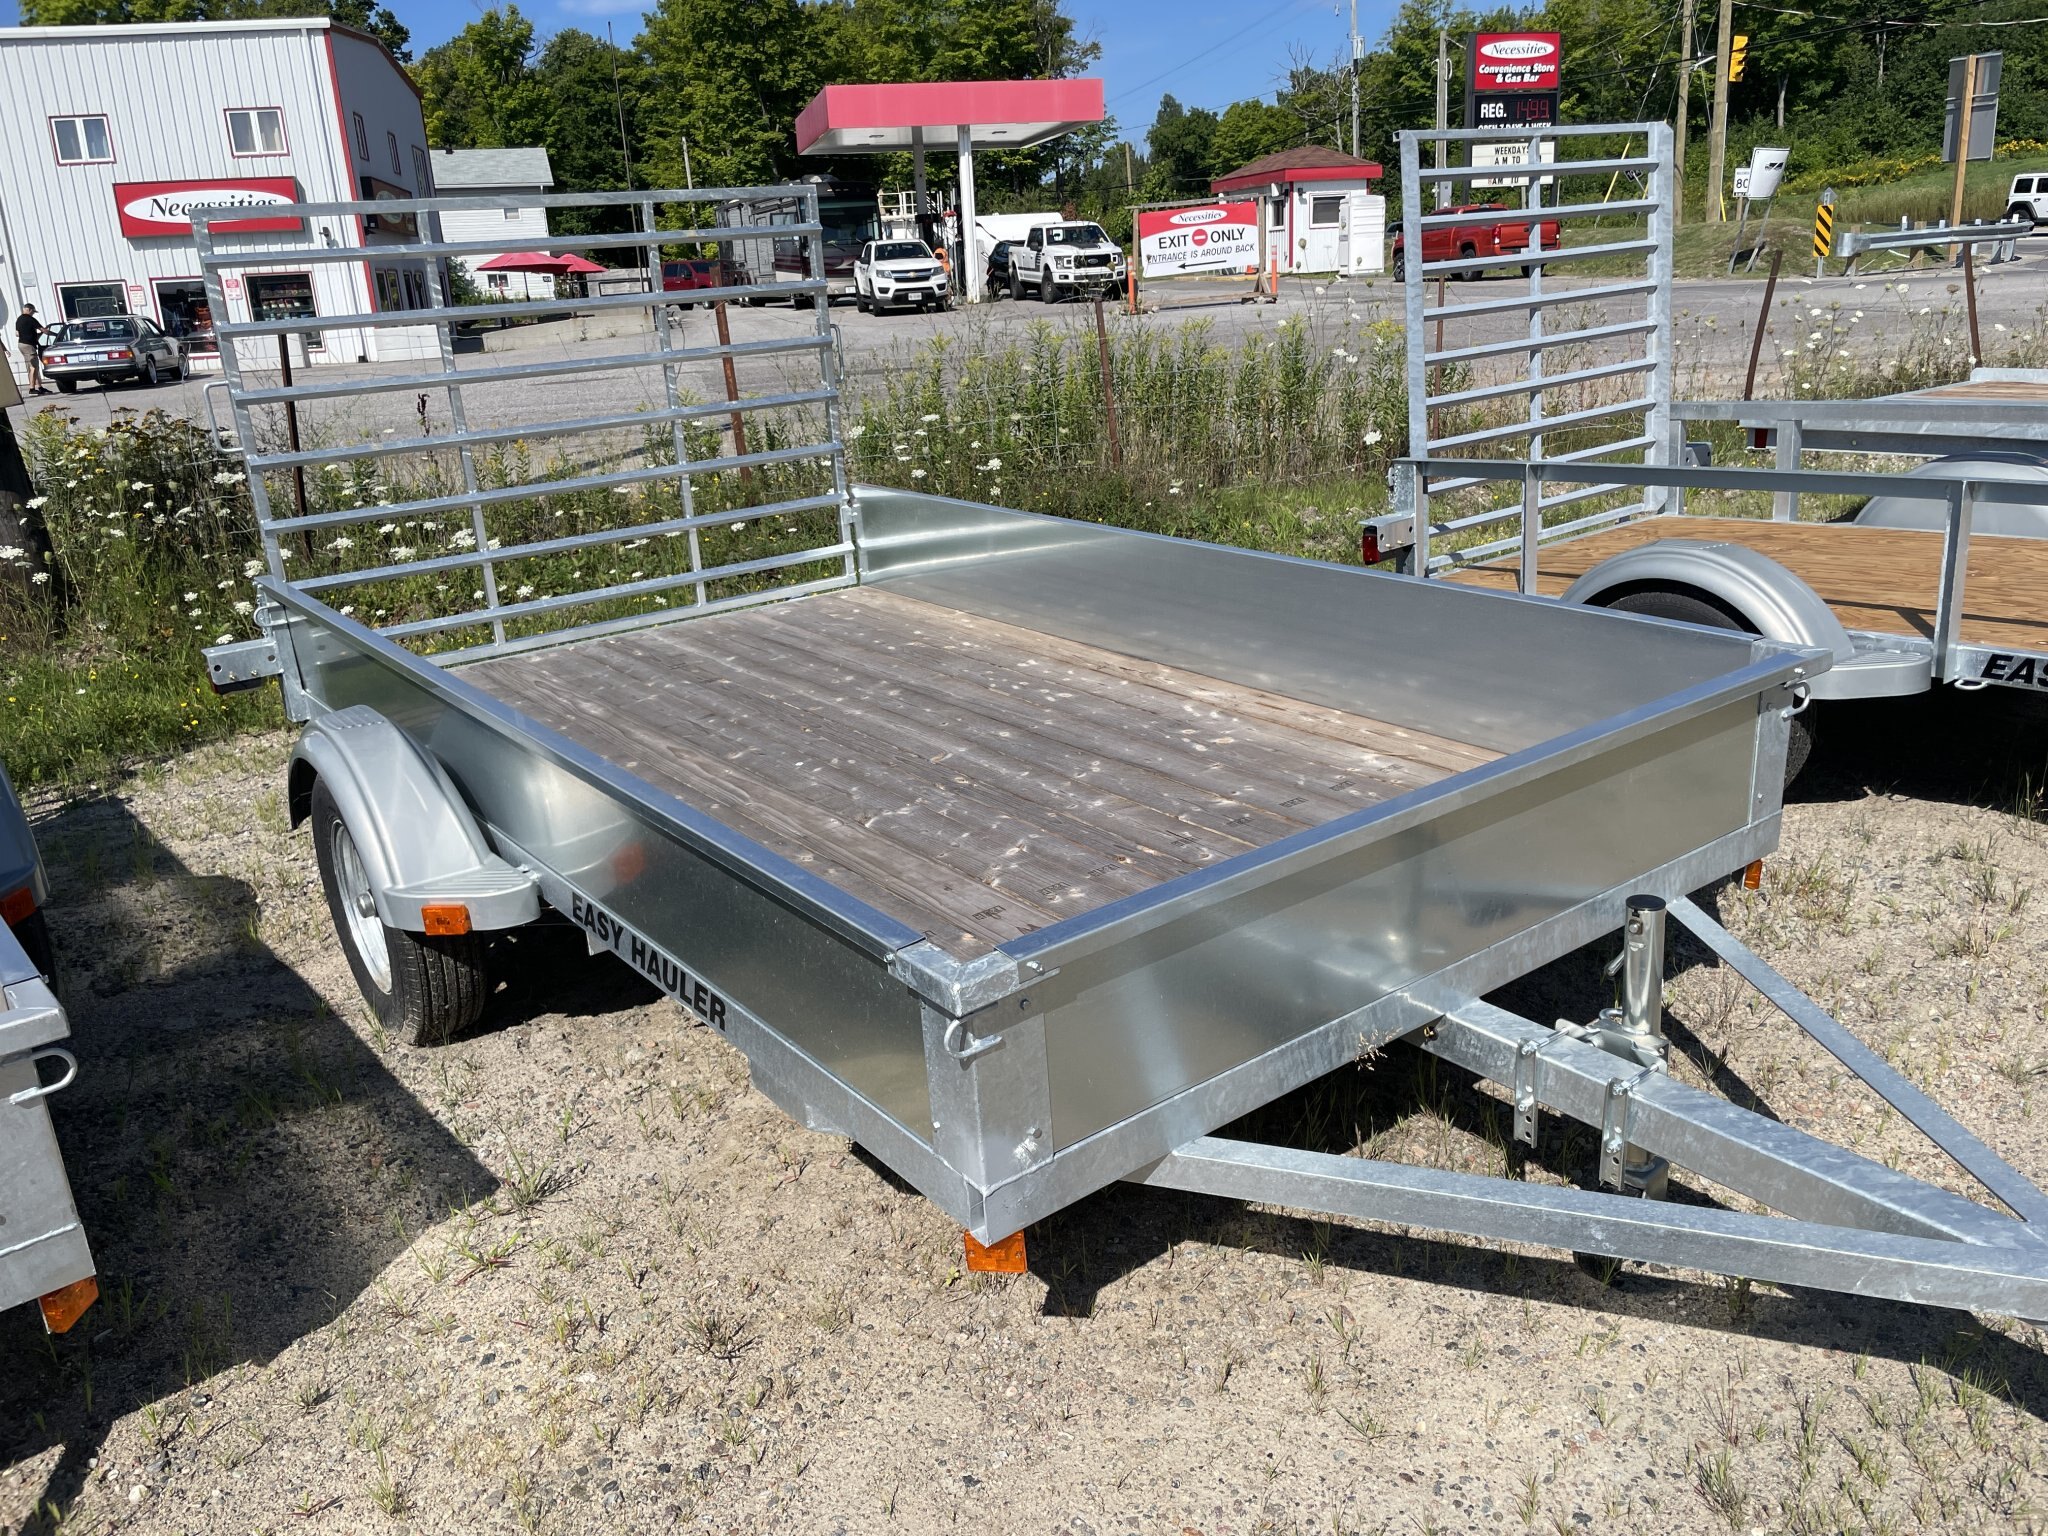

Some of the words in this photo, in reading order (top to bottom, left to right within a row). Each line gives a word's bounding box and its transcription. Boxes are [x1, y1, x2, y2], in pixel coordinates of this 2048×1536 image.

[1491, 43, 1548, 55] Necessities
[1479, 64, 1531, 74] Convenience
[1533, 63, 1555, 73] Store
[1496, 74, 1503, 83] &
[1505, 74, 1521, 83] Gas
[1523, 73, 1540, 82] Bar
[1480, 103, 1507, 118] REG.
[1513, 156, 1521, 164] TO
[150, 194, 277, 217] Neciti
[1178, 211, 1222, 223] Necessities
[1158, 234, 1189, 249] EXIT
[1210, 228, 1246, 243] ONLY
[1147, 252, 1187, 263] ENTRANCE
[1191, 249, 1198, 258] IS
[1201, 246, 1232, 257] AROUND
[1235, 243, 1255, 253] BACK
[572, 892, 624, 950] EASY
[631, 935, 726, 1032] HAULER
